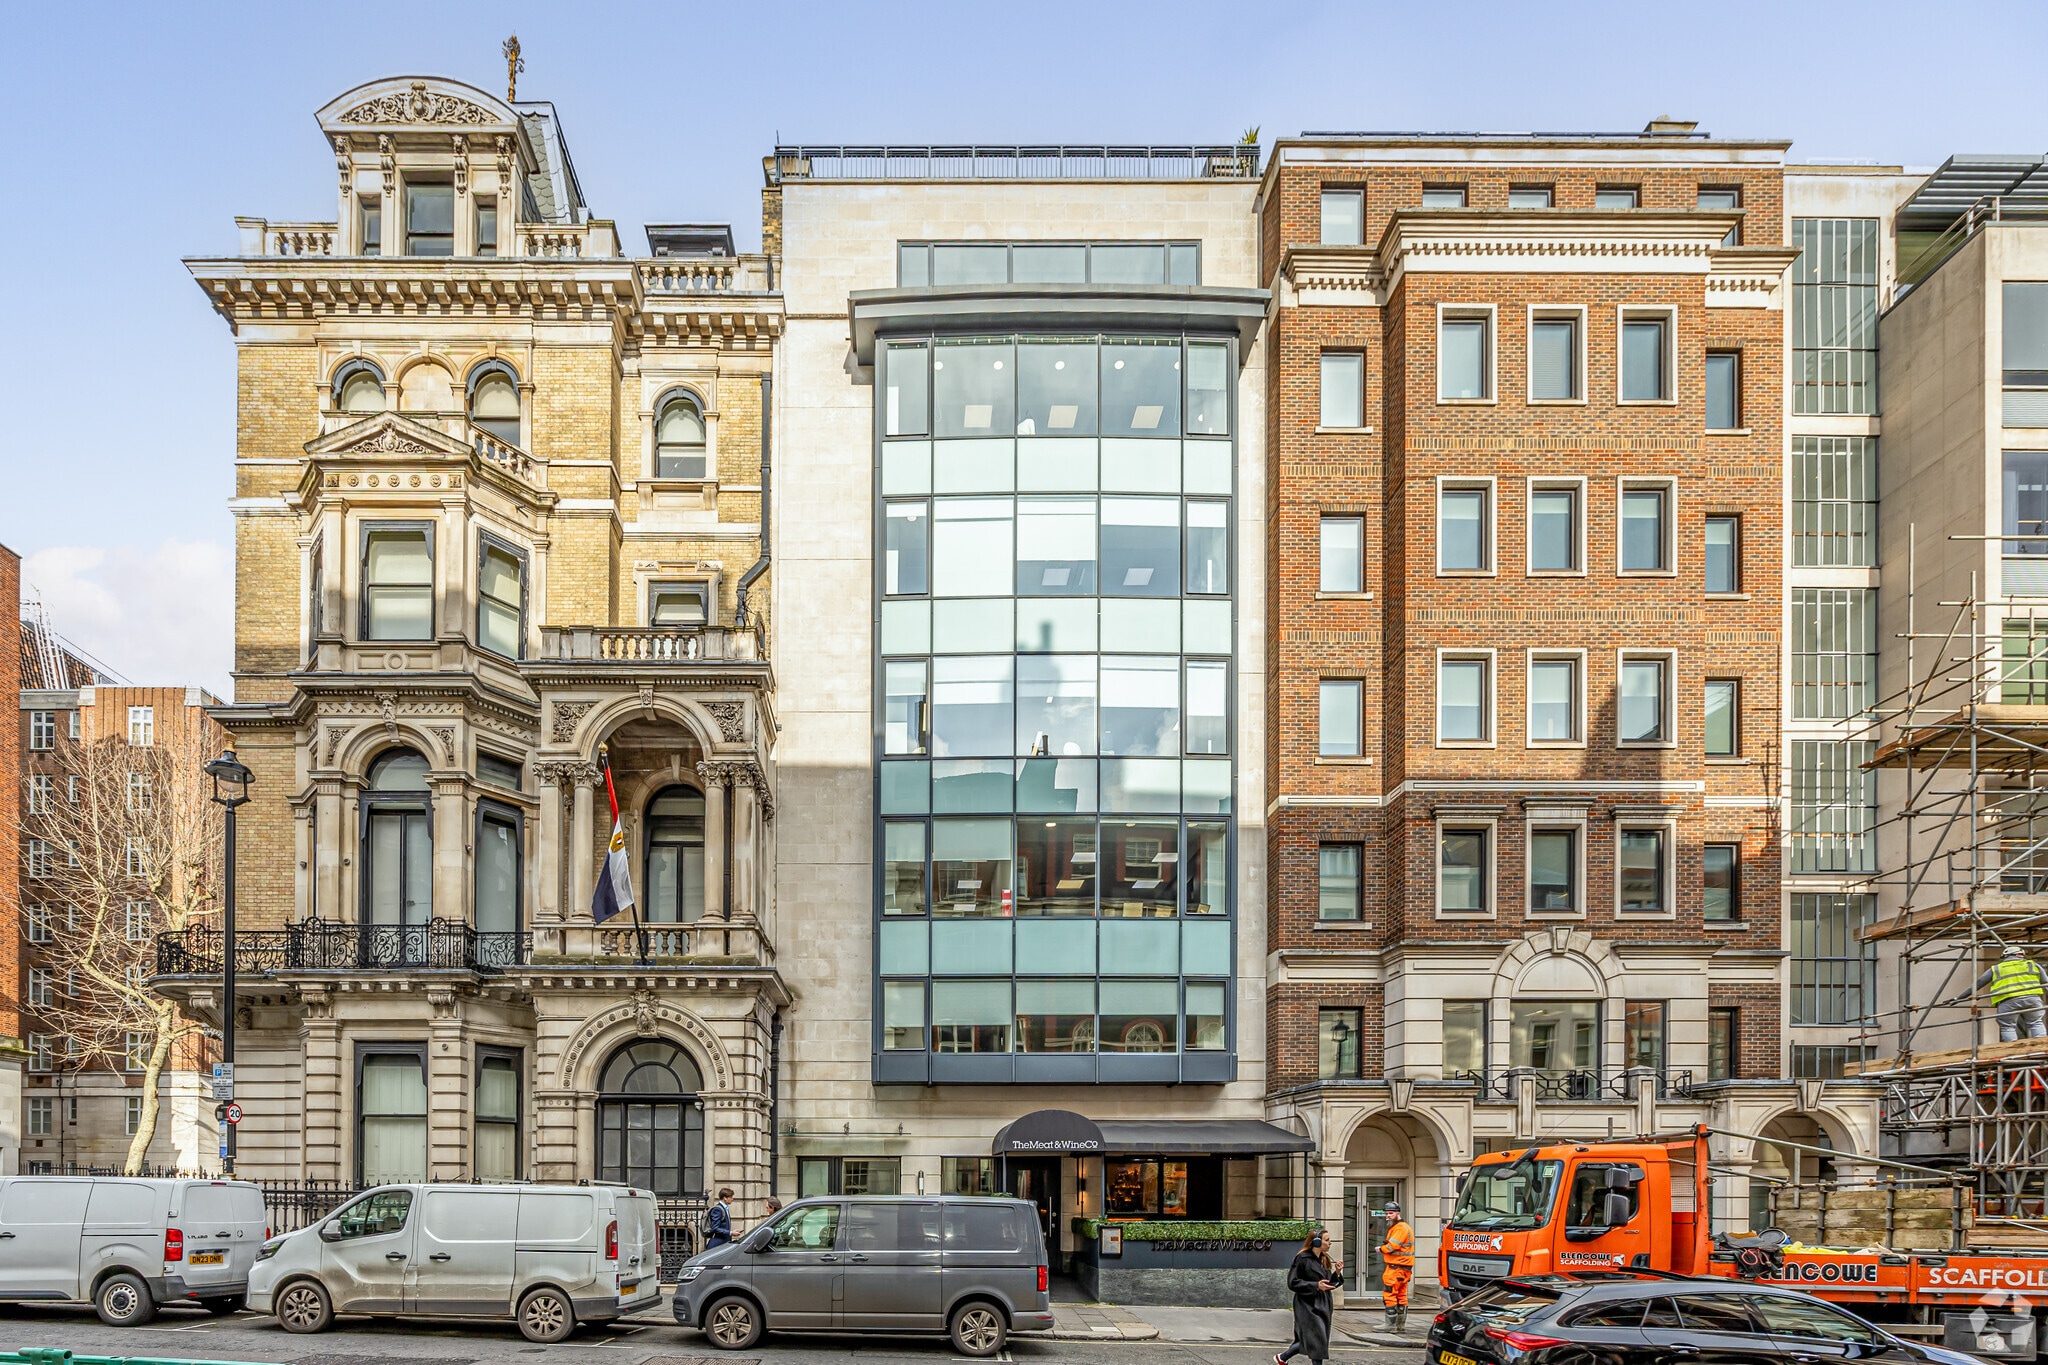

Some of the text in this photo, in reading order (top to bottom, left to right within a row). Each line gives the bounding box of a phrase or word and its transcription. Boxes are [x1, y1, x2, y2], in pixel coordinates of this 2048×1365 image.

[230, 1109, 240, 1117] 20
[1454, 1233, 1491, 1243] BLENCOWE
[1453, 1243, 1489, 1251] SCAFFOLDING
[1560, 1252, 1611, 1260] BLENCOWE
[1463, 1264, 1485, 1272] DAF
[1759, 1262, 1878, 1282] ENCOWE
